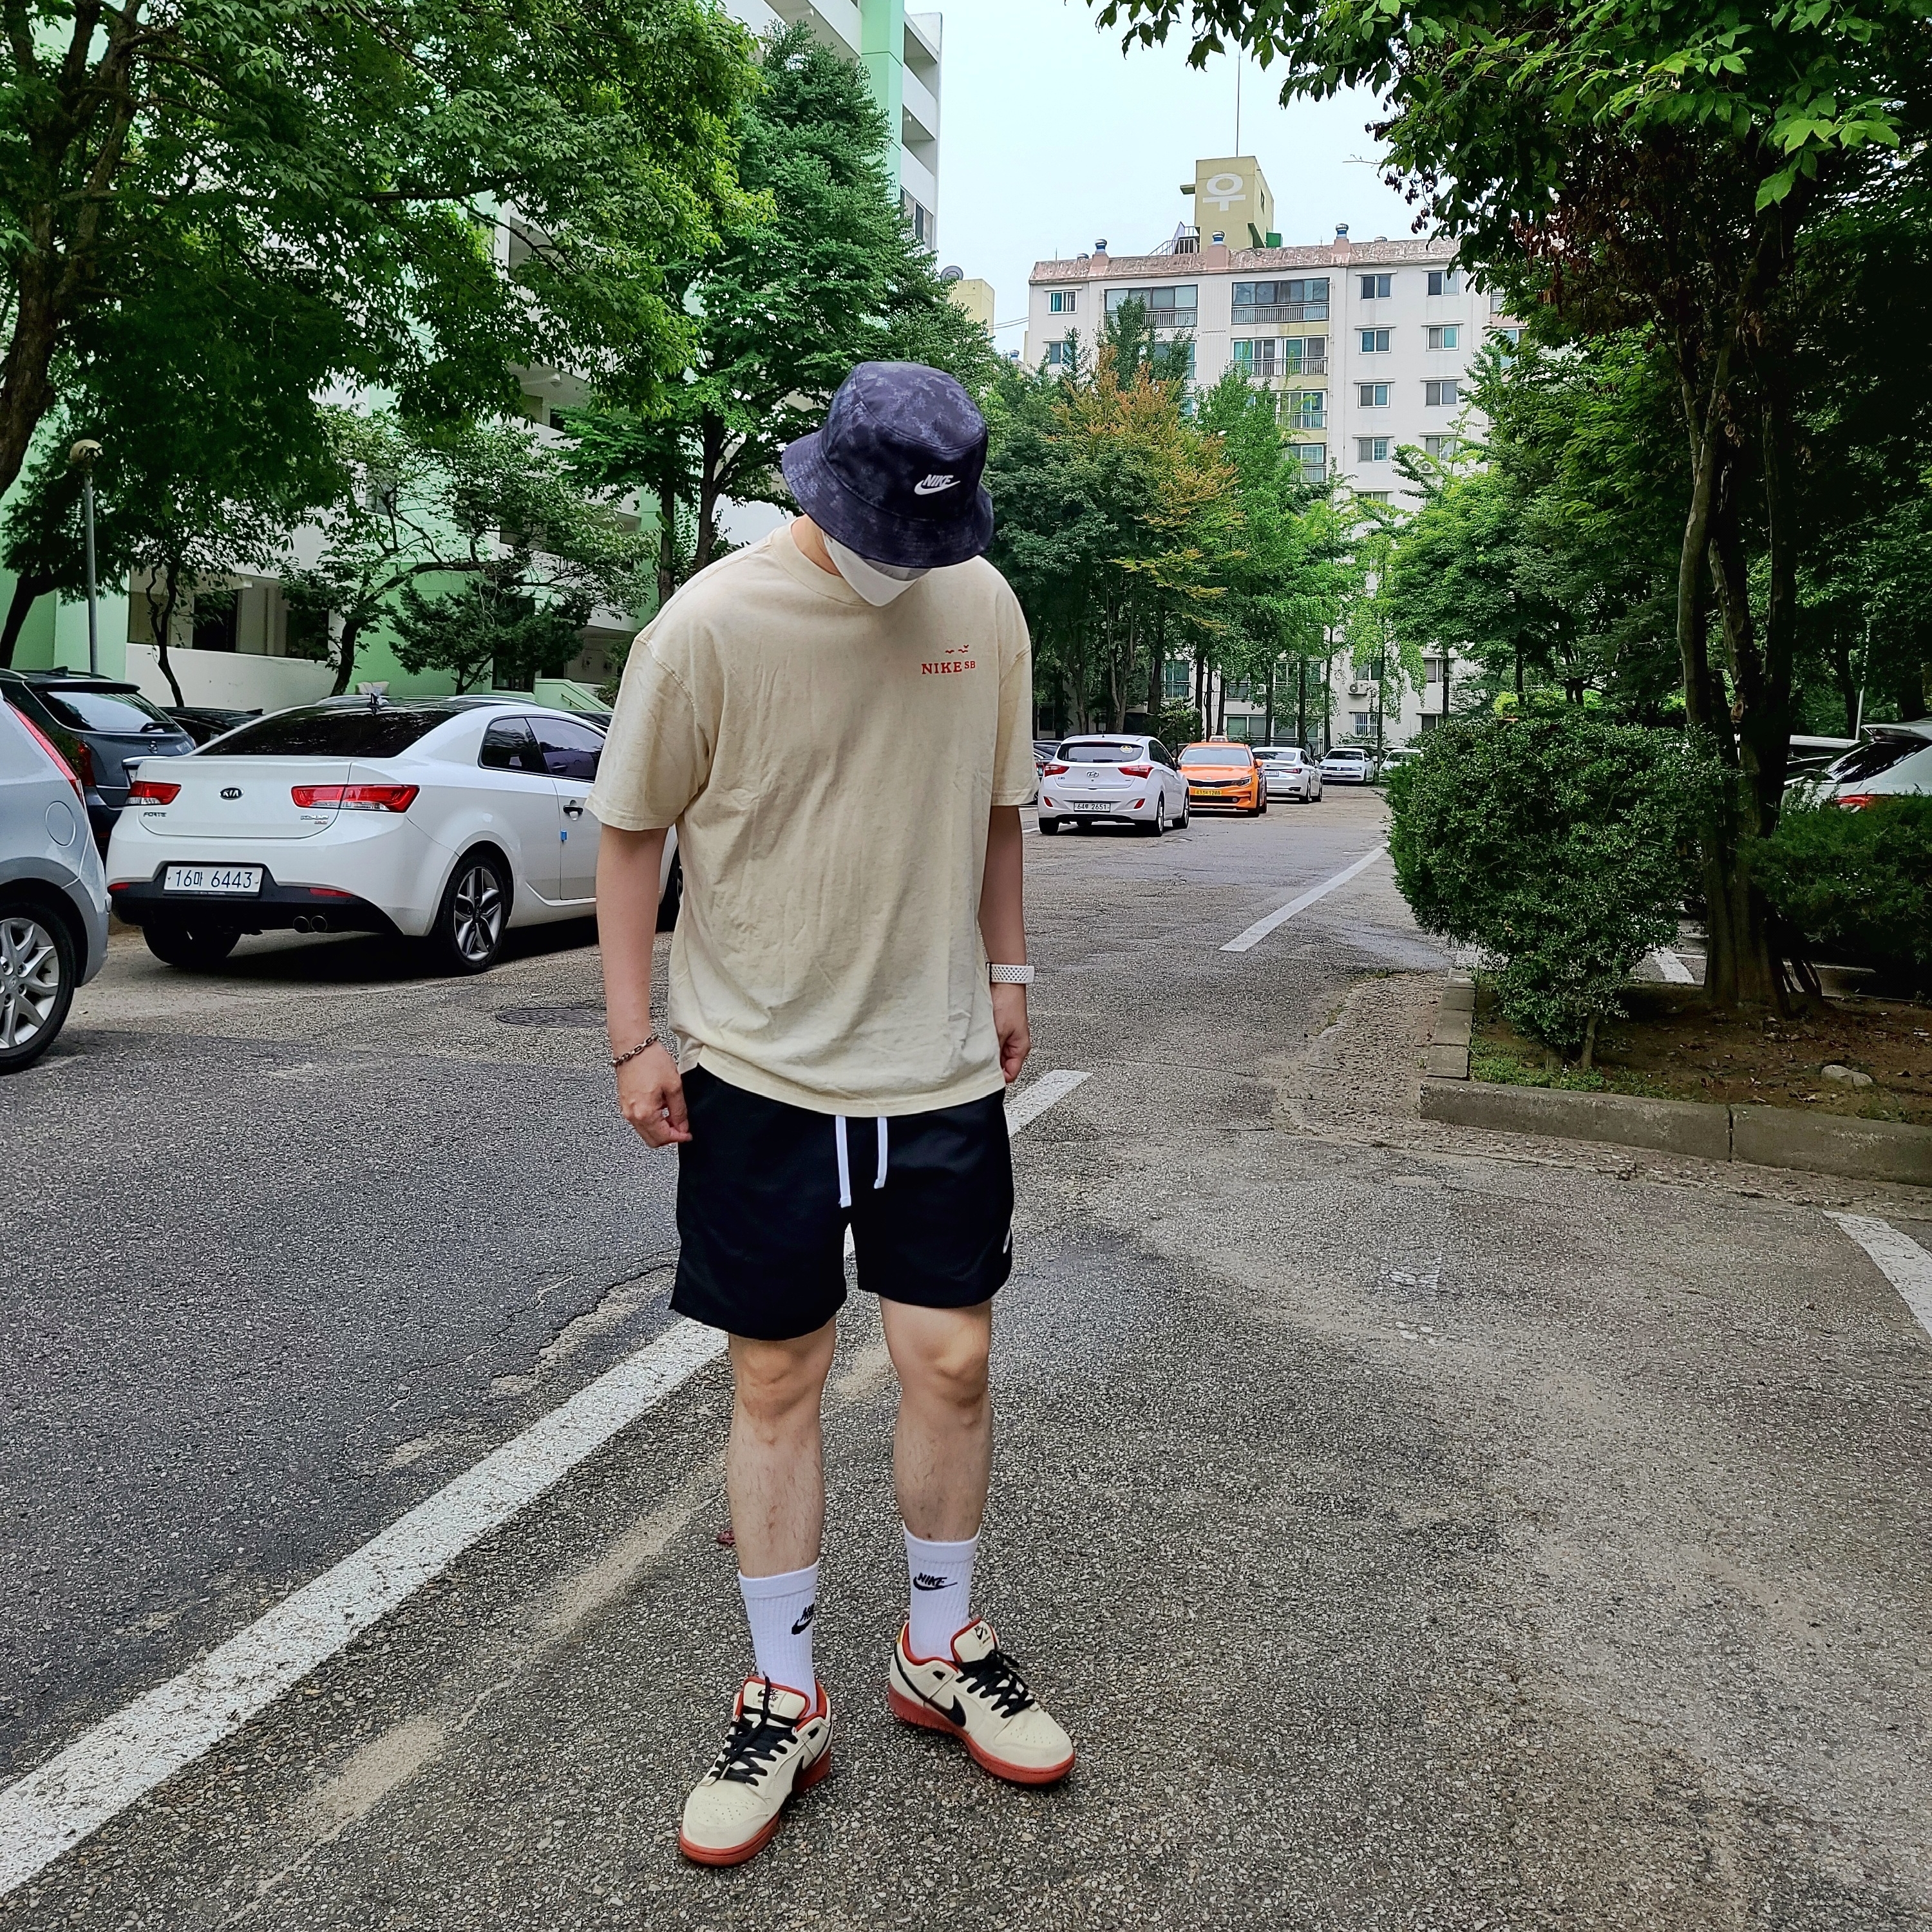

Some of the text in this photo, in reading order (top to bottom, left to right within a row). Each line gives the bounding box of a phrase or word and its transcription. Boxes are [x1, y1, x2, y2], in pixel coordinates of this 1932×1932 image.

[922, 474, 954, 487] NIKE
[922, 661, 962, 674] NIKE
[176, 869, 253, 889] 16마 6443
[917, 1572, 948, 1586] NIKE
